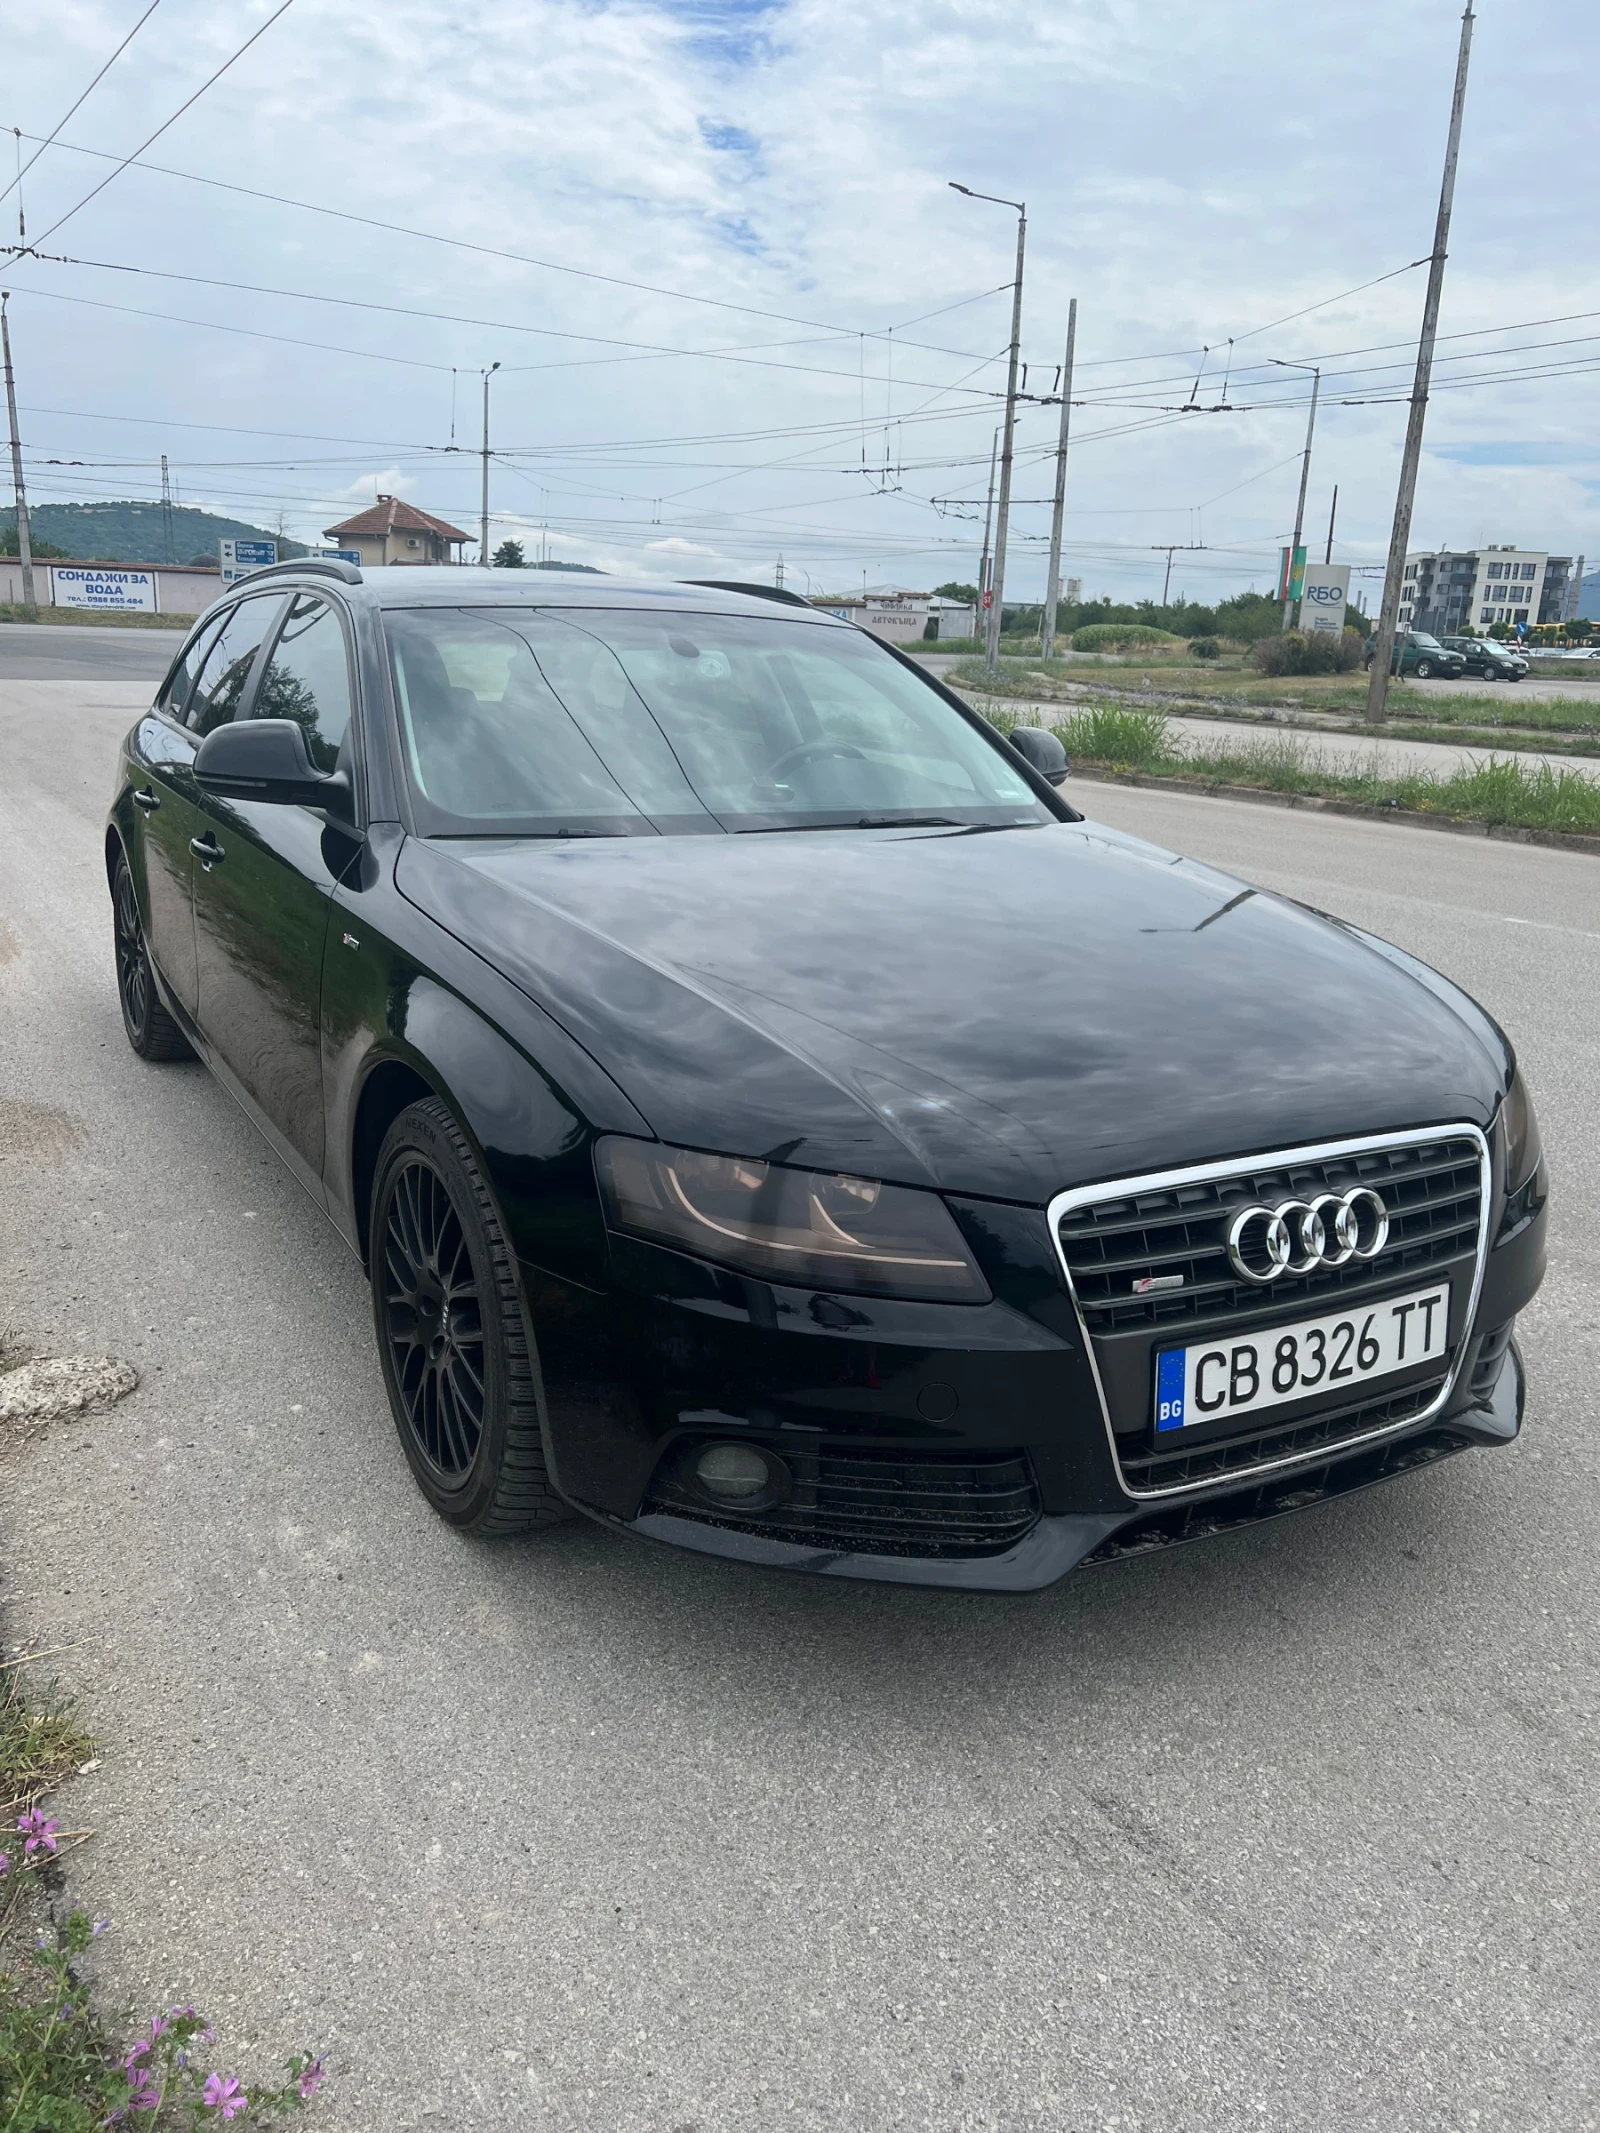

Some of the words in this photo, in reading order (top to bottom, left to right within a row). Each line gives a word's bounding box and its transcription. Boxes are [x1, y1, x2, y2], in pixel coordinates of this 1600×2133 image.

[58, 571, 128, 583] СОНДАЖИ
[131, 575, 148, 584] ЗА
[86, 585, 123, 595] ВОДА
[872, 616, 917, 626] АВТОКЪЩА
[406, 1118, 436, 1144] NEXEN
[1195, 1345, 1259, 1411] CB
[1271, 1313, 1380, 1393] 8326
[1392, 1294, 1442, 1360] TT
[1159, 1399, 1182, 1421] BG
